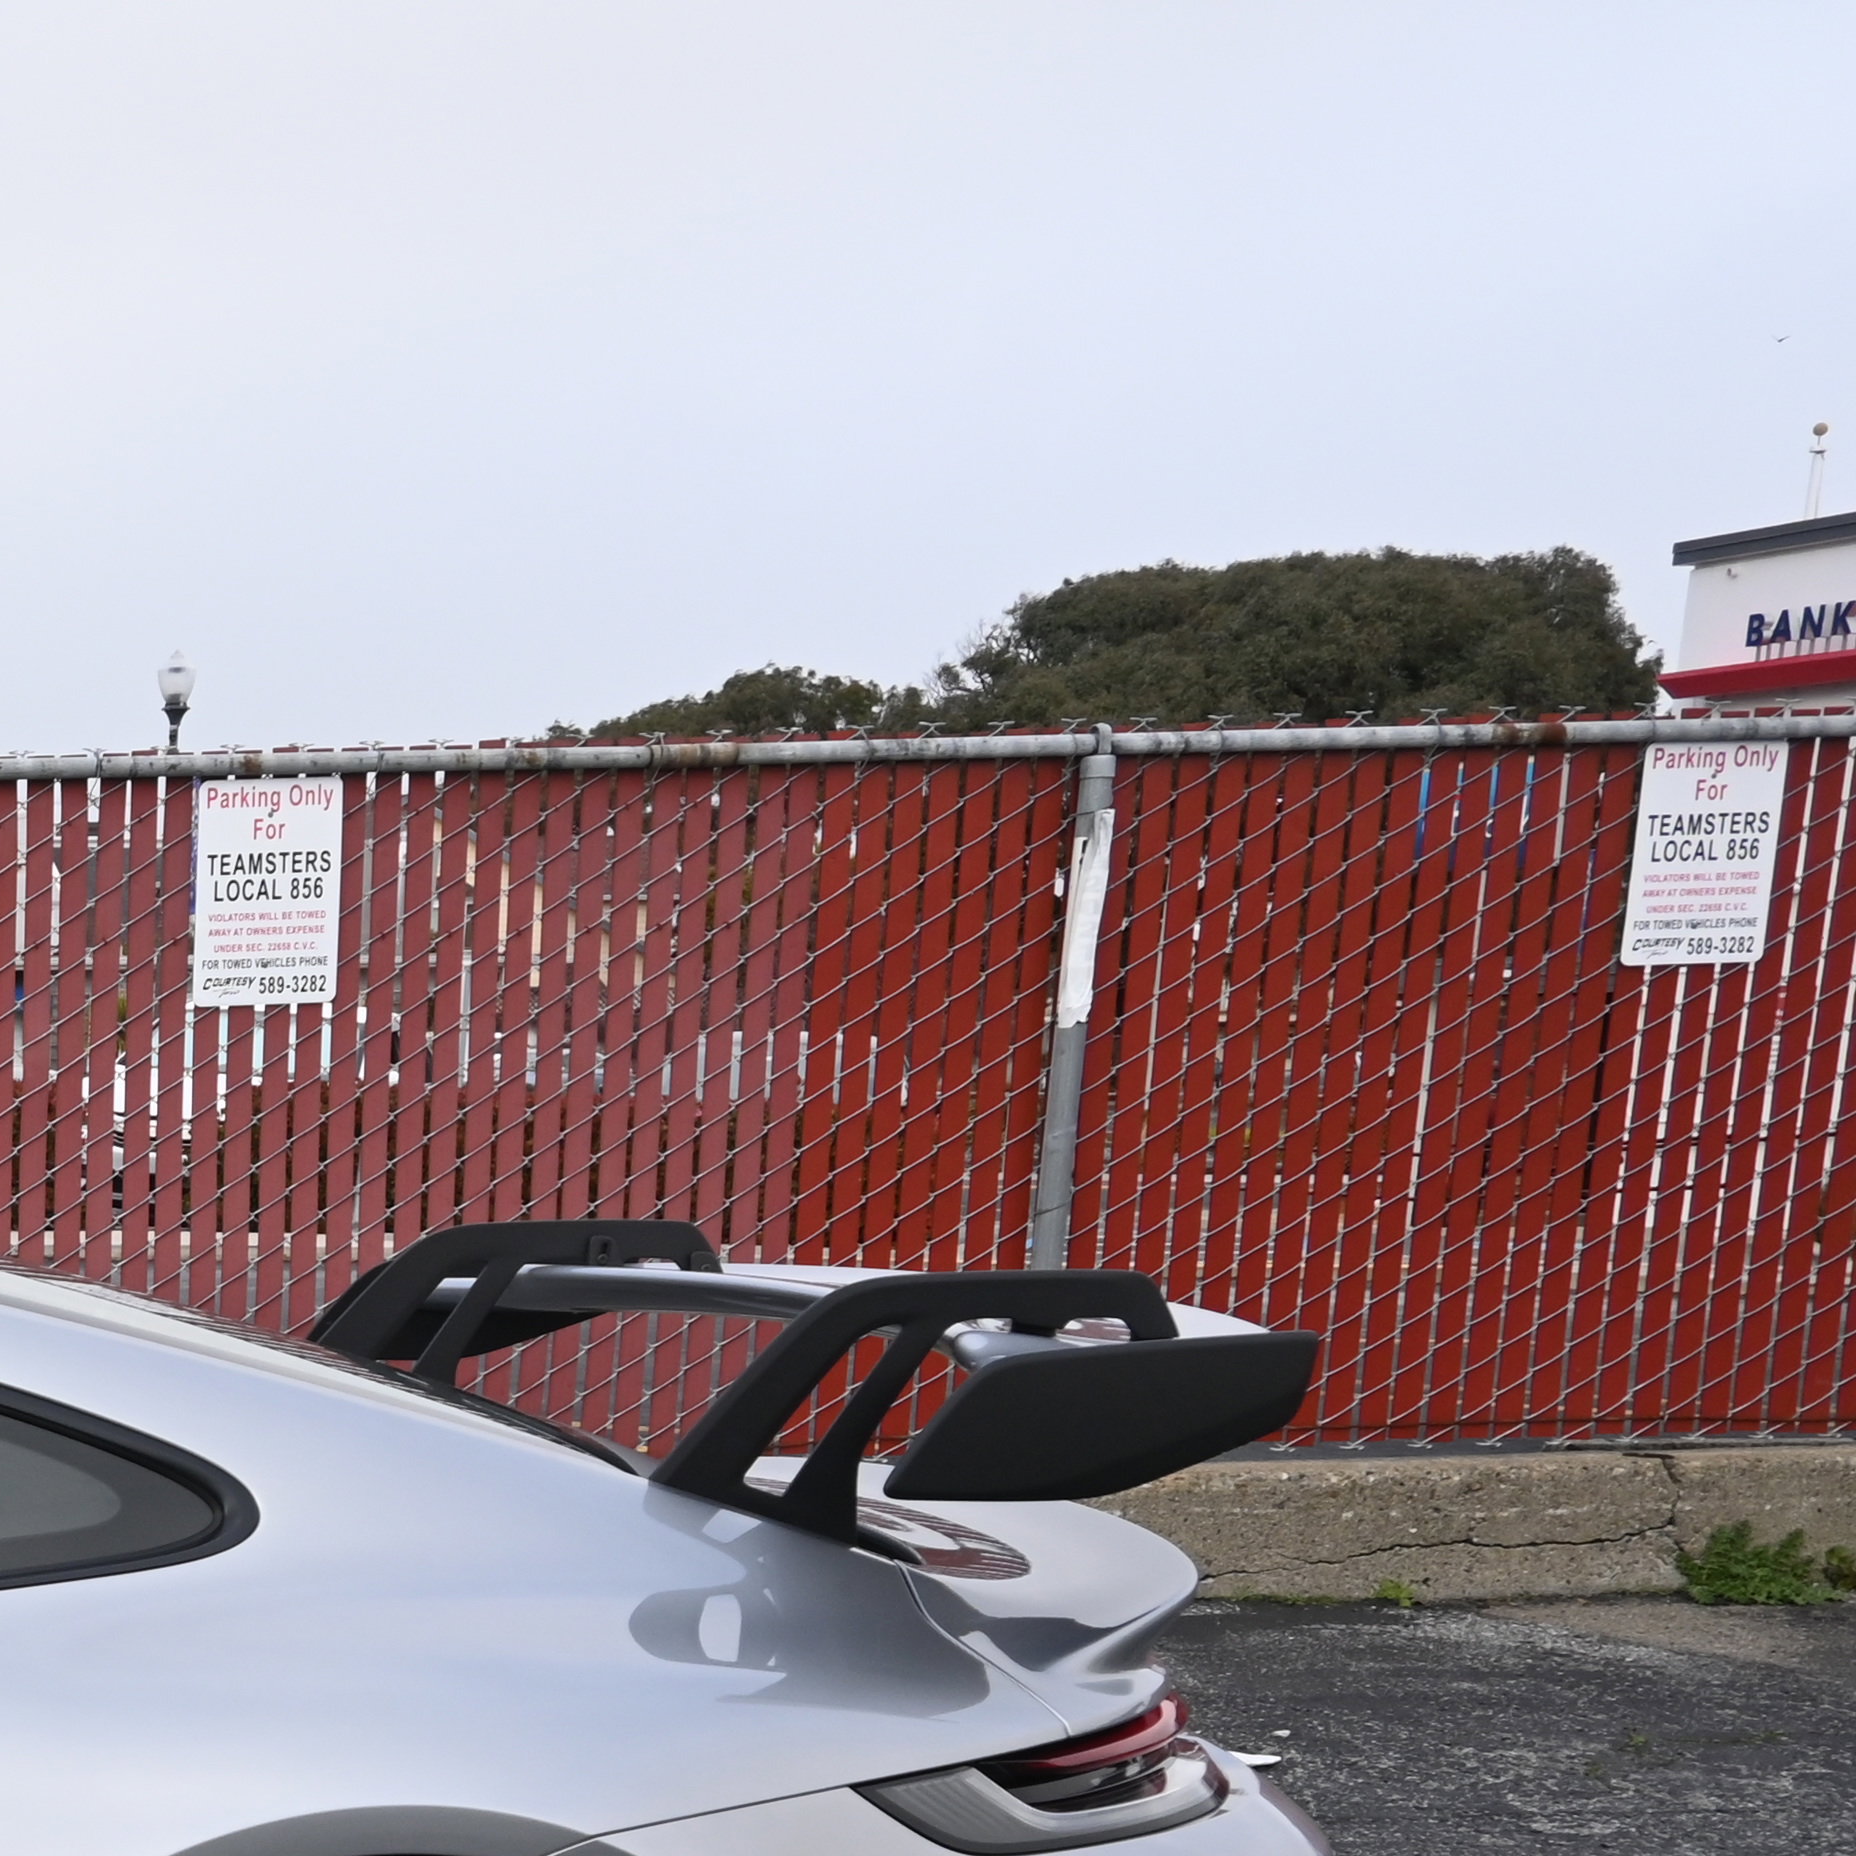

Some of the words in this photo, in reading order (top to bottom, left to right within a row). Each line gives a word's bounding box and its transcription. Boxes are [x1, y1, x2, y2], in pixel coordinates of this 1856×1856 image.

[1746, 600, 1856, 647] BANK
[1652, 746, 1726, 773] Parking
[1734, 744, 1779, 772] Only
[207, 785, 281, 812] Parking
[289, 784, 334, 811] Only
[1695, 779, 1728, 801] For
[253, 818, 286, 840] For
[1648, 811, 1771, 837] TEAMSTERS
[1651, 840, 1719, 863] LOCAL
[1726, 838, 1760, 860] 856
[207, 850, 332, 876] TEAMSTERS
[1643, 873, 1690, 883] VIOLATORS
[1693, 872, 1713, 881] WILL
[1716, 871, 1727, 880] BE
[1730, 871, 1760, 880] TOWED
[214, 878, 282, 902] LOCAL
[290, 877, 324, 899] 856
[1666, 888, 1677, 897] AT
[208, 912, 256, 922] VIOLATORS
[259, 911, 279, 921] WILL
[281, 911, 294, 920] BE
[297, 910, 327, 919] TOWED
[1633, 920, 1650, 930] FOR
[1653, 919, 1683, 930] TOWED
[1685, 918, 1726, 929] VEHICLES
[1728, 917, 1758, 928] PHONE
[208, 928, 231, 937] AWAY
[233, 928, 244, 936] AT
[246, 926, 283, 936] OWNERS
[286, 925, 325, 935] EXPENSE
[214, 943, 243, 953] UNDER
[1632, 937, 1685, 951] COURTESY
[1686, 936, 1755, 955] 589-3282
[202, 960, 219, 970] FOR
[222, 958, 253, 969] TOWED
[255, 957, 297, 968] VEHICLES
[299, 955, 329, 967] PHONE
[202, 976, 256, 990] COURTESY
[259, 974, 328, 994] 589-3282
